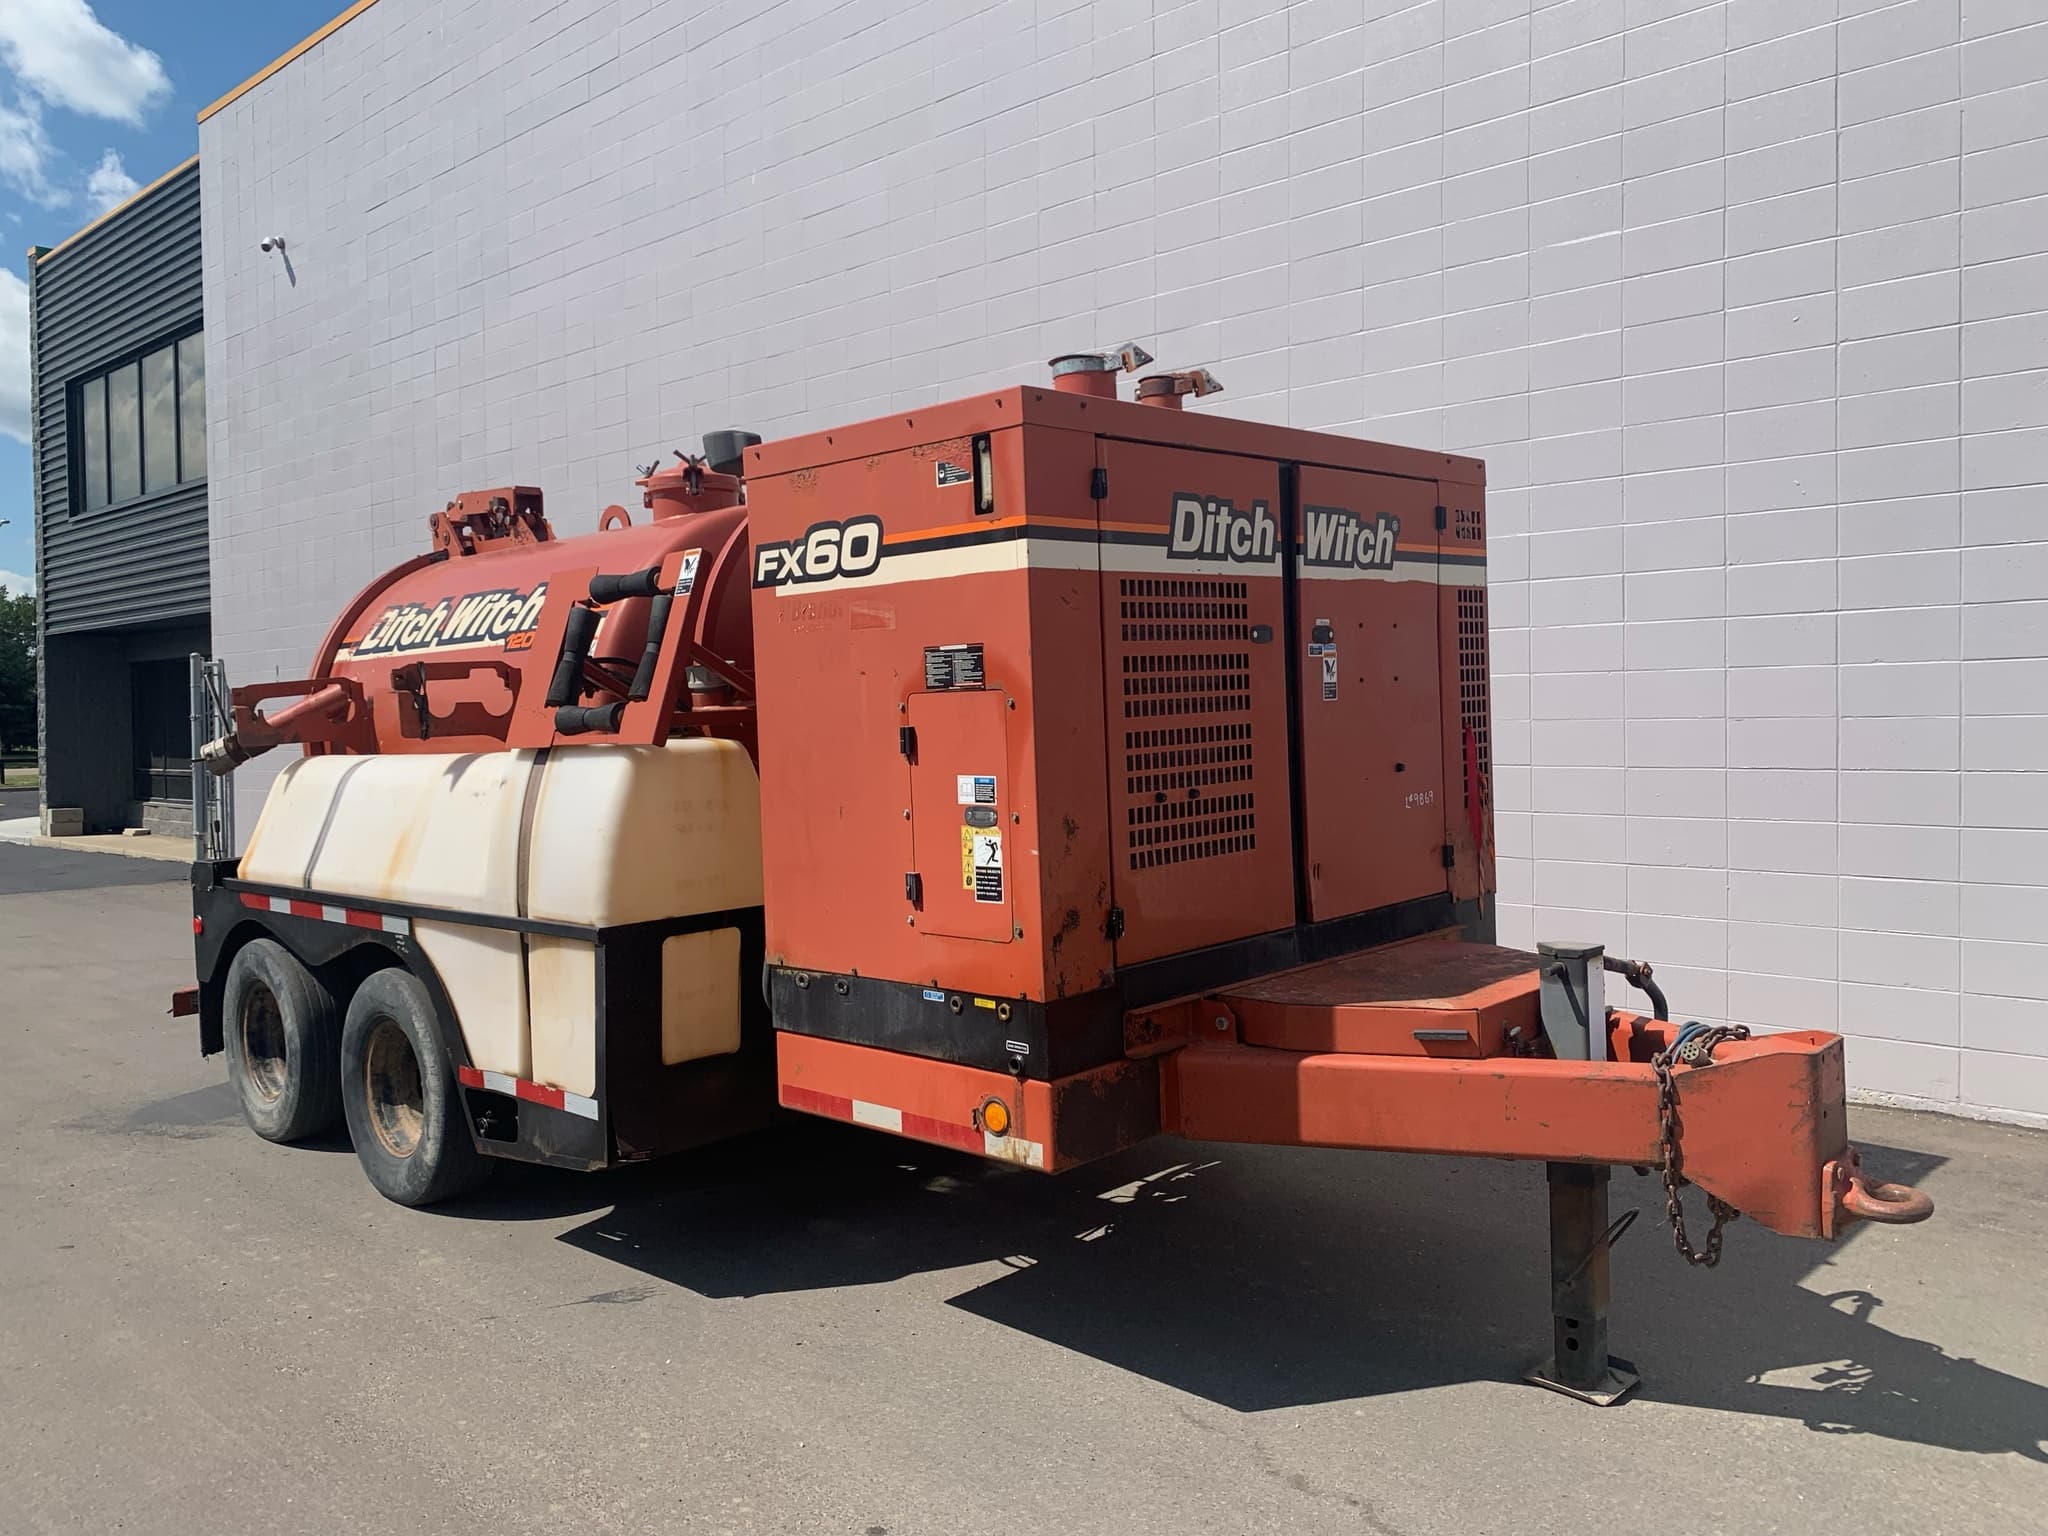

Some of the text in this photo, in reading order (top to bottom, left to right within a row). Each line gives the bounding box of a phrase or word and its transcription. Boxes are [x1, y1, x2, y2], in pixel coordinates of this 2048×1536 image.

[757, 522, 880, 582] FX60
[1172, 500, 1275, 556] Ditch
[361, 585, 546, 649] Ditch Witch
[506, 633, 535, 649] 120
